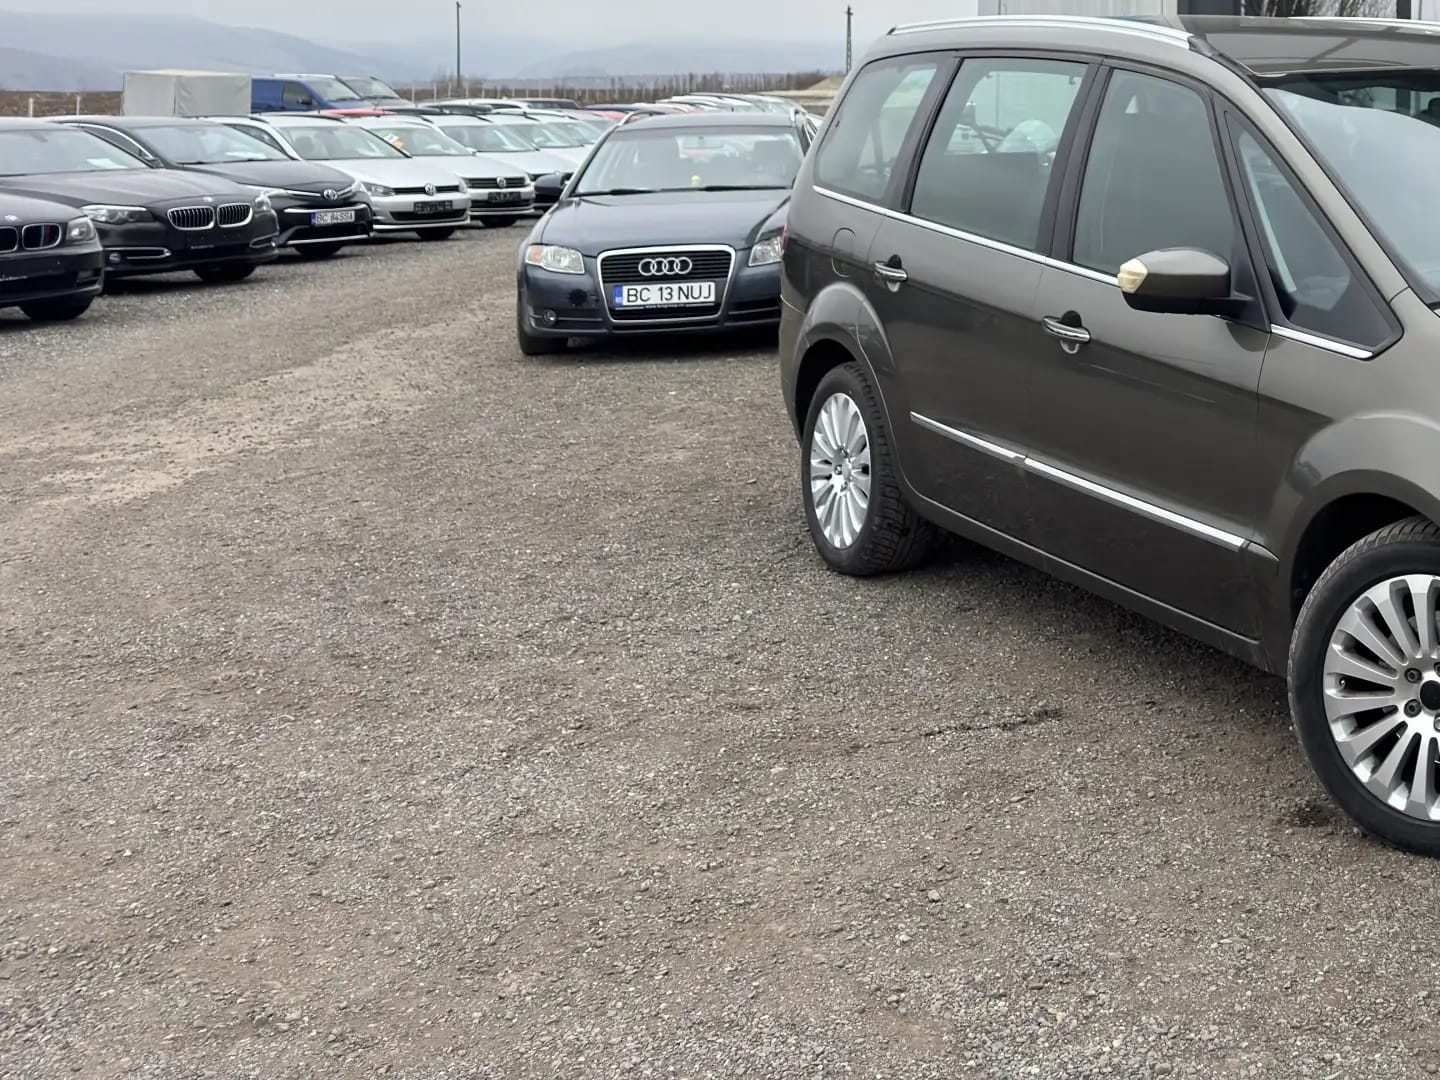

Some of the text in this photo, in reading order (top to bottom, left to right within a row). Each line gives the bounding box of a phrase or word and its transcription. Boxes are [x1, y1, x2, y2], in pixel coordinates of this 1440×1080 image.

[626, 287, 651, 303] BC
[658, 285, 674, 302] 13
[678, 284, 712, 300] NUJ
